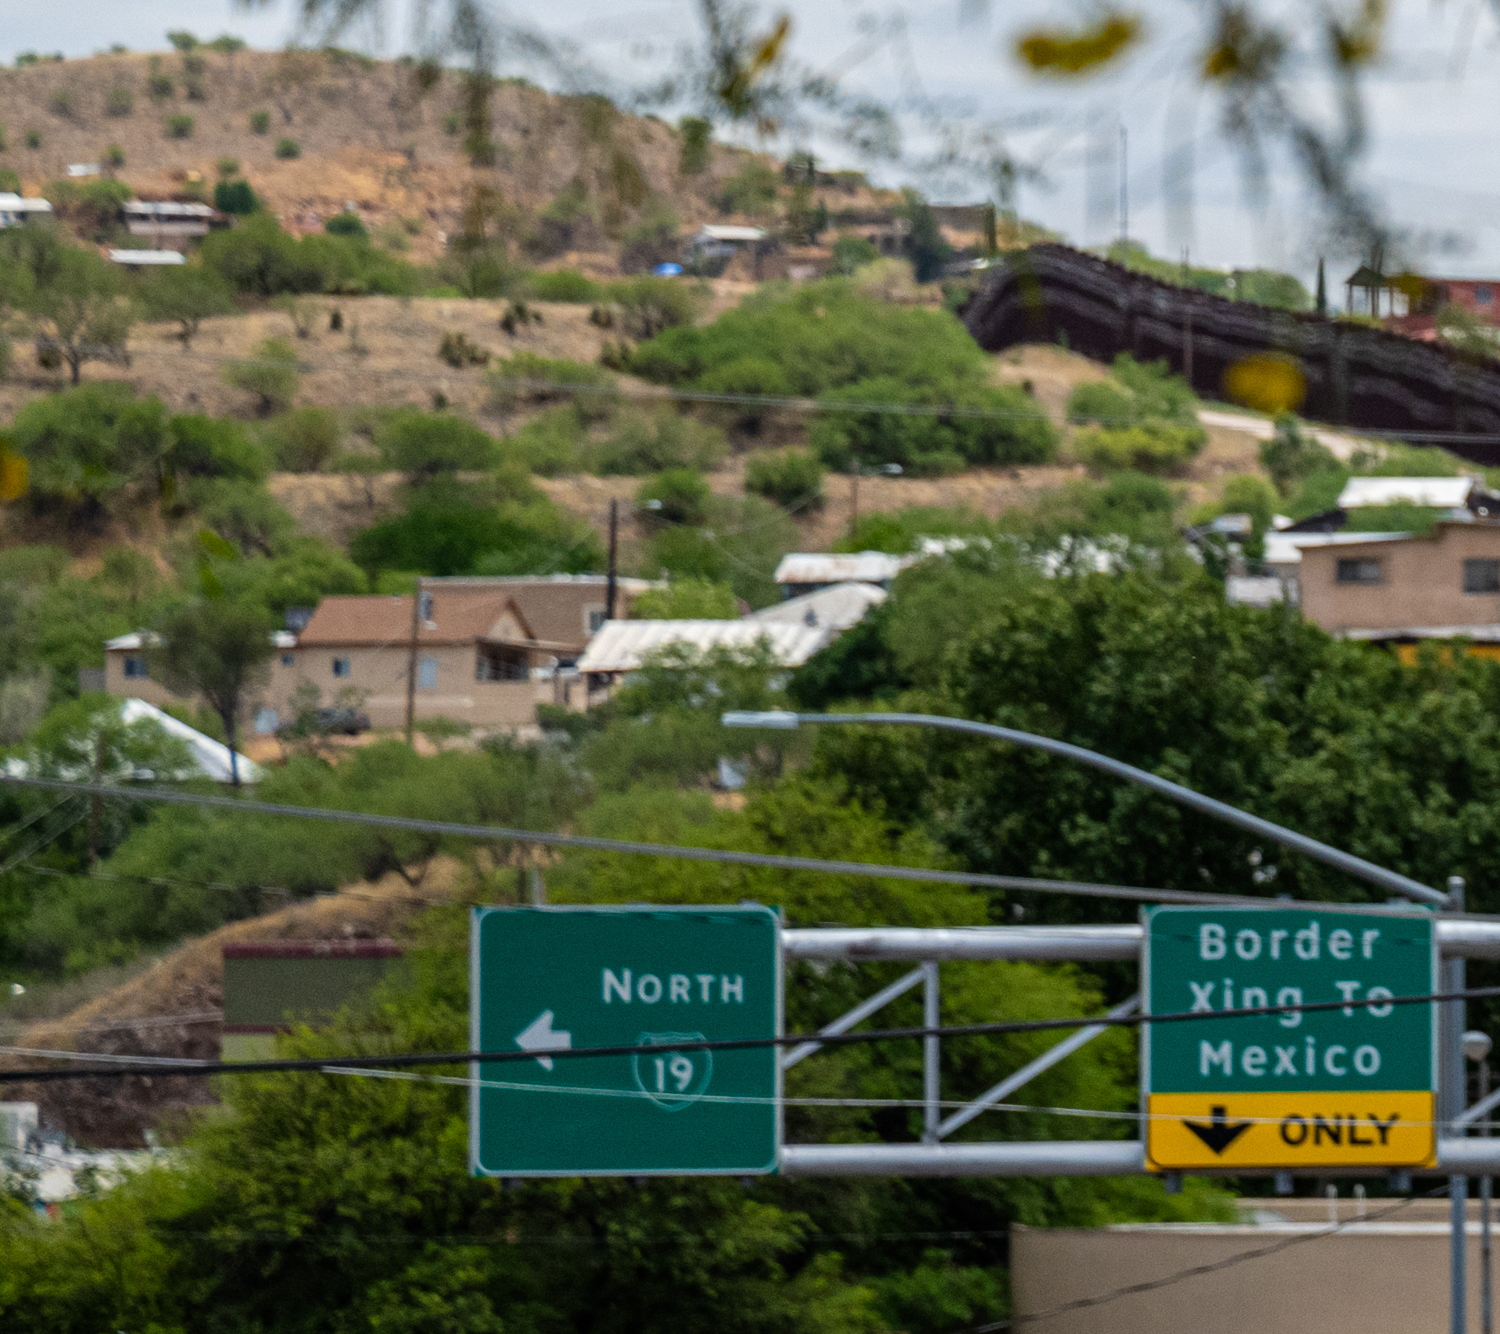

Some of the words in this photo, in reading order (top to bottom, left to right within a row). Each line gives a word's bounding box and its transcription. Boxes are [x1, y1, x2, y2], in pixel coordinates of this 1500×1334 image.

[1200, 923, 1379, 961] Border
[601, 967, 745, 1004] NORTH
[1189, 981, 1302, 1029] Xing
[1335, 981, 1395, 1018] To
[653, 1056, 694, 1092] 19
[1200, 1040, 1381, 1078] Mexico
[1280, 1112, 1400, 1148] ONLY
